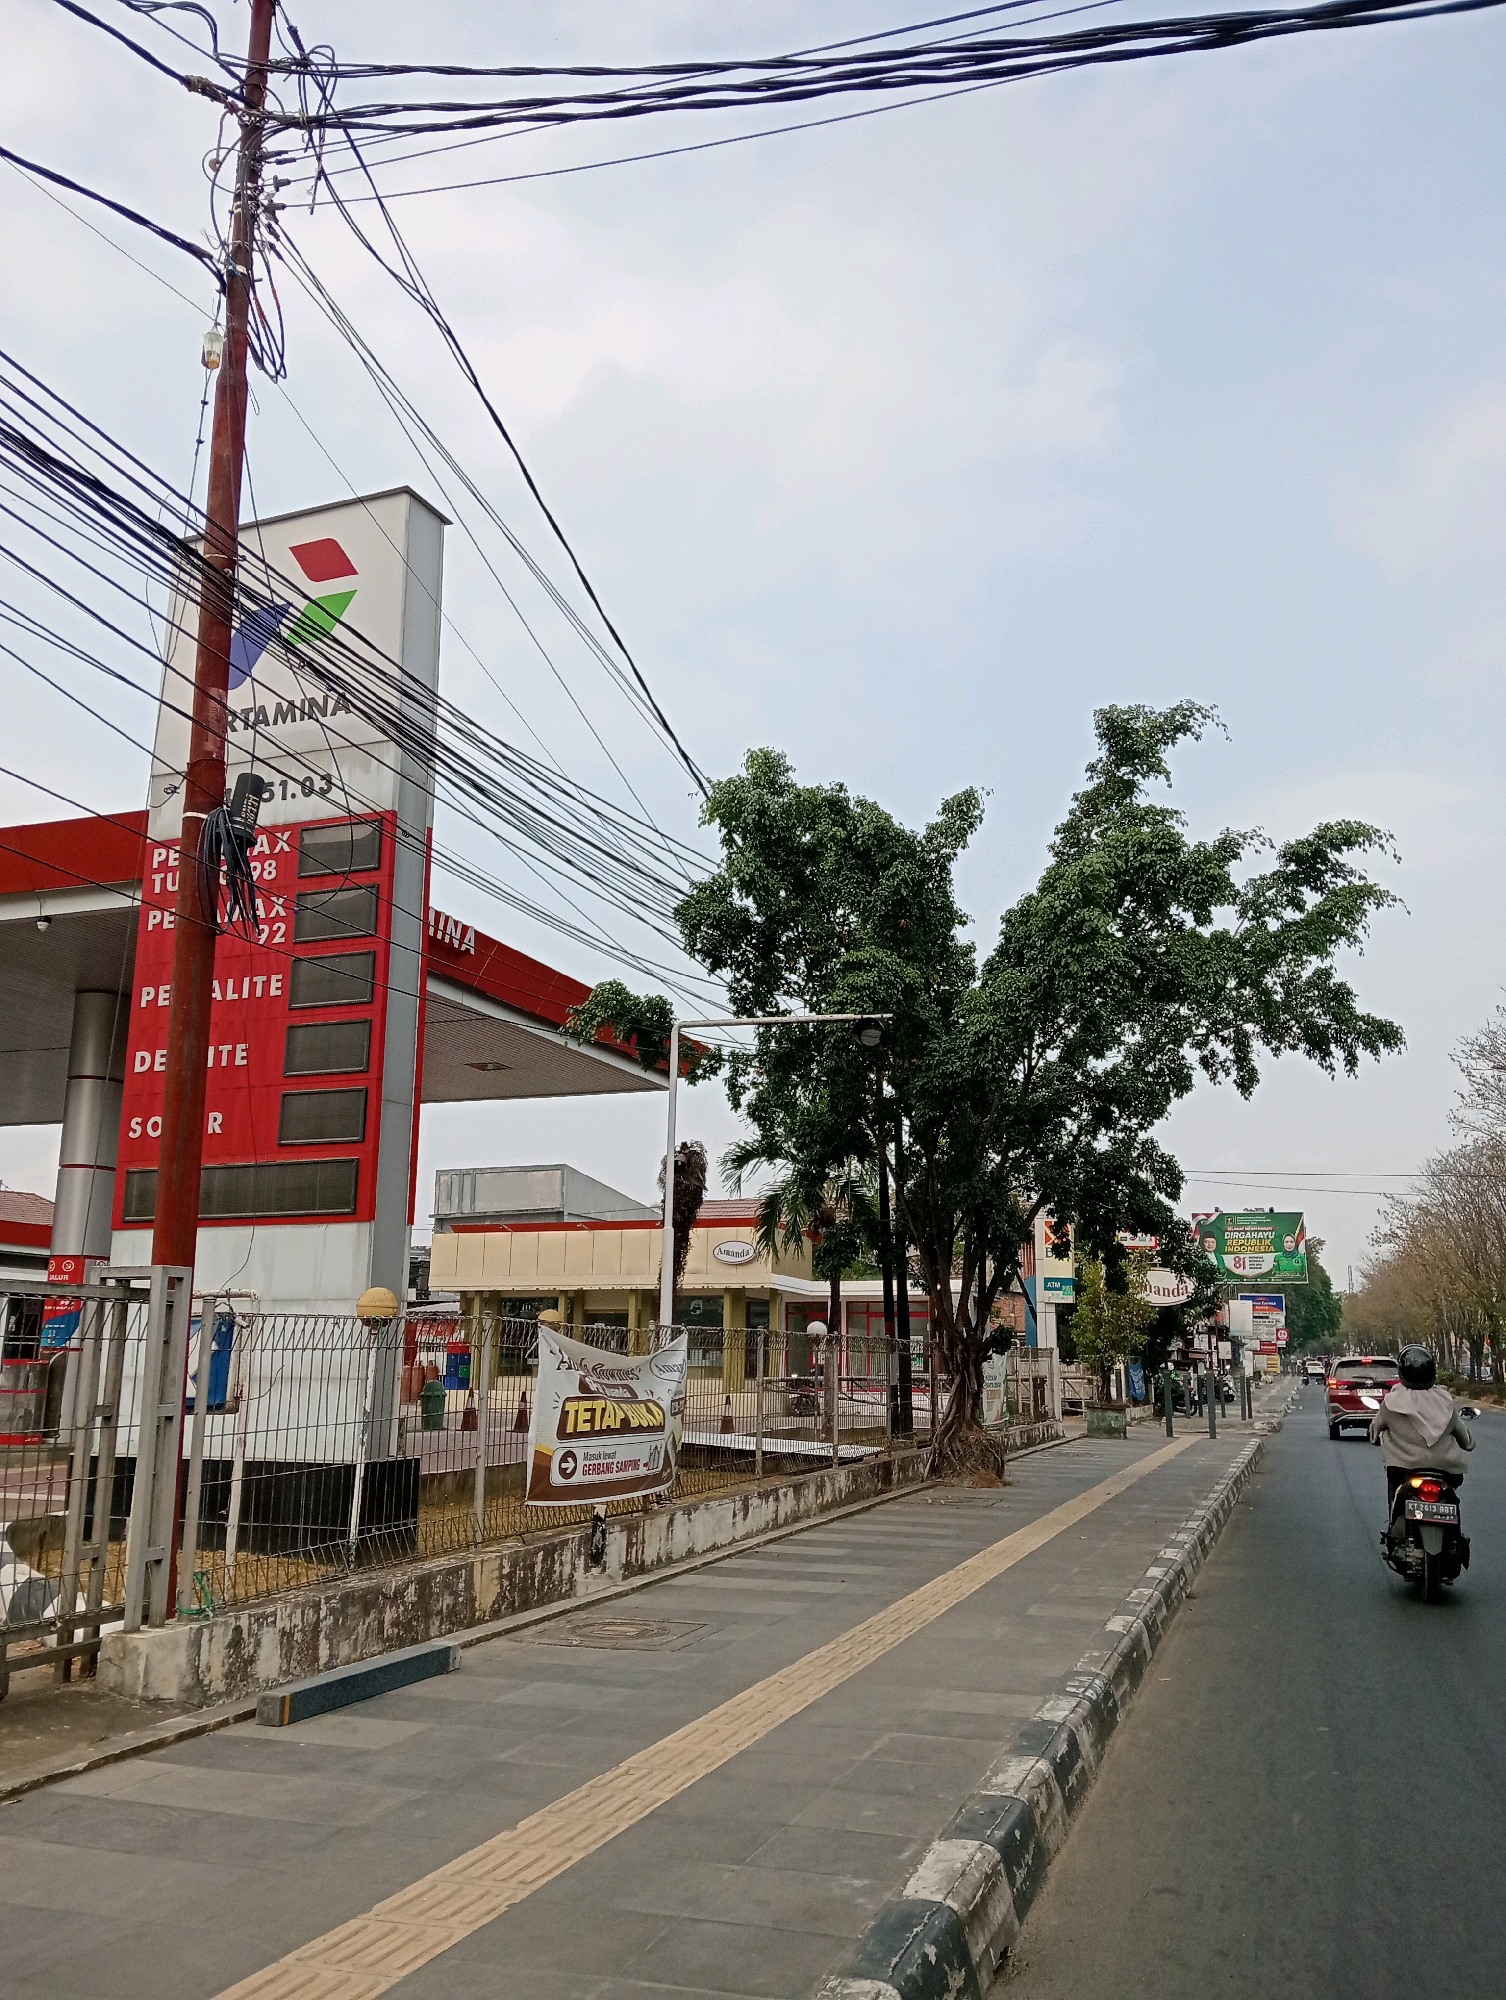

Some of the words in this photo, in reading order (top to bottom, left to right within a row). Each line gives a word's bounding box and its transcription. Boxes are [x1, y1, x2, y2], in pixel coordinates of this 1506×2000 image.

[256, 922, 287, 946] 92
[140, 974, 283, 1009] PEALITE
[133, 1043, 249, 1074] DEITE
[1224, 1231, 1275, 1239] DIRGAHAYU
[717, 1247, 750, 1258] Amanda
[565, 1400, 625, 1433] TETAP
[626, 1402, 664, 1428] BUKA
[583, 1451, 602, 1461] Masuk
[582, 1462, 614, 1476] GERBANG
[615, 1459, 641, 1473] SAMPING
